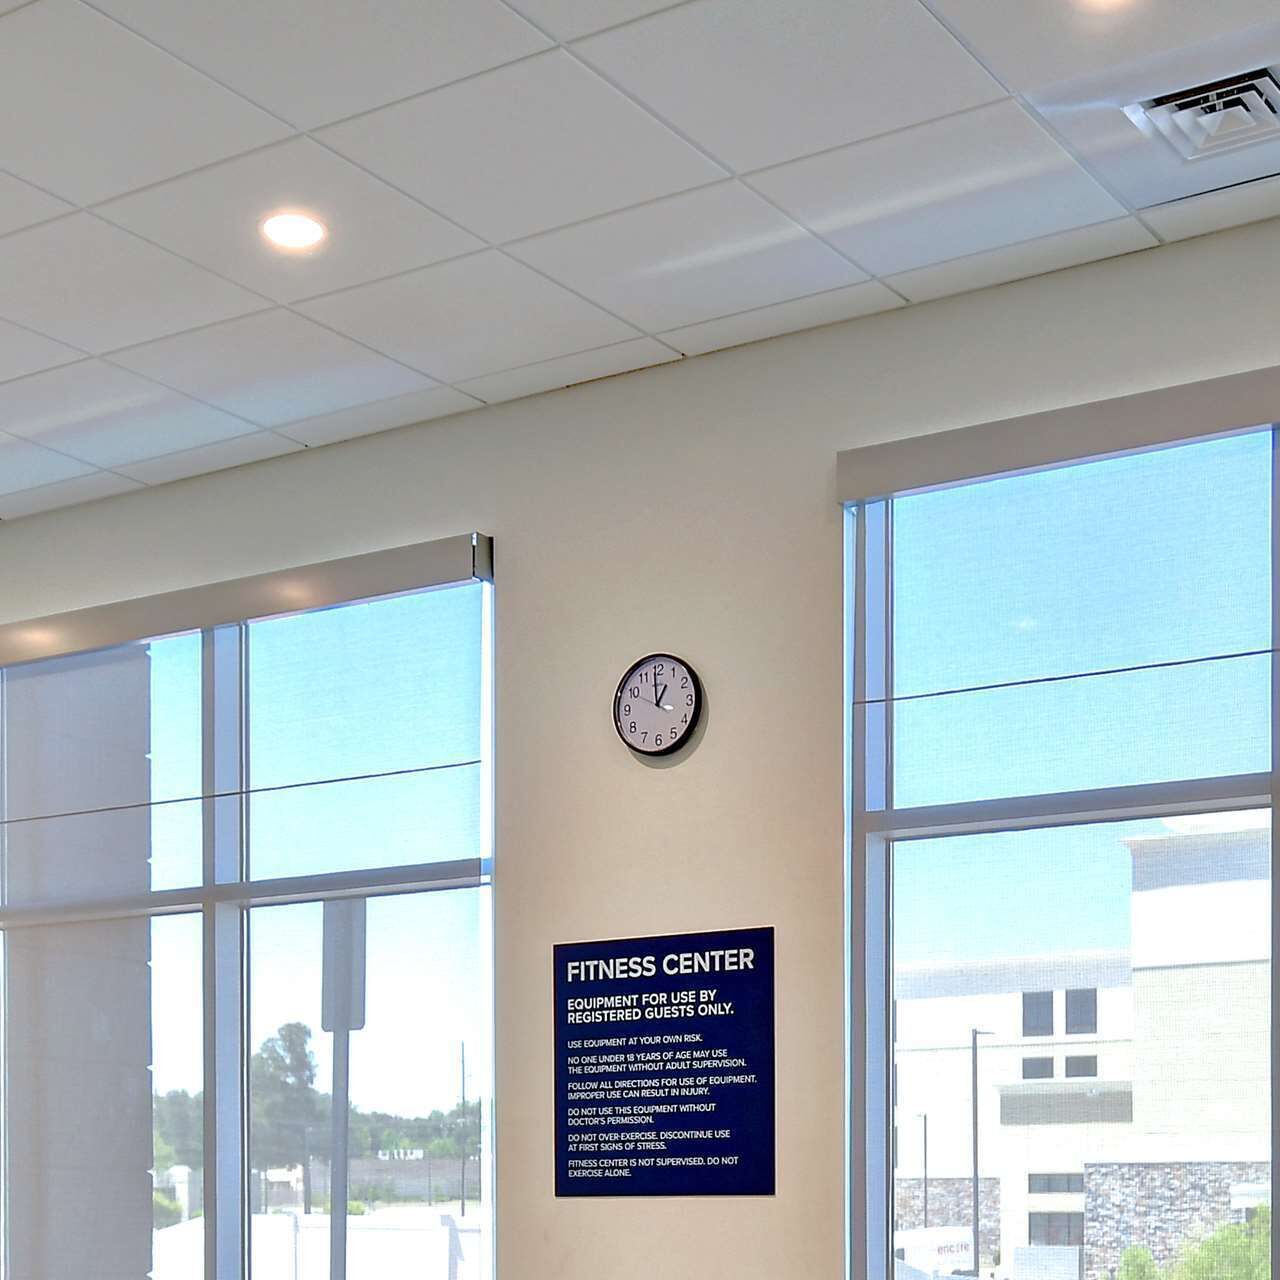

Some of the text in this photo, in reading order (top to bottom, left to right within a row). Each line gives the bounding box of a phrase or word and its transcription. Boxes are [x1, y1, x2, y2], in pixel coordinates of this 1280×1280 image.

[639, 672, 648, 683] 11
[672, 667, 675, 678] 1
[681, 677, 688, 688] 2
[629, 686, 639, 698] 10
[686, 694, 693, 706] 3
[624, 705, 631, 716] 9
[681, 713, 688, 724] 4
[630, 722, 636, 733] 8
[670, 727, 677, 739] 5
[641, 732, 648, 743] 7
[655, 734, 663, 746] 6
[567, 948, 754, 981] FITNESS CENTER
[567, 989, 716, 1010] EQUIPMENT FOR USE BY
[567, 1002, 733, 1023] REGISTERED GUESTS ONLY.
[567, 1033, 702, 1048] USE EQUIPMENT AT YOUR OWN RISK.
[567, 1049, 727, 1064] NO ONE UNDER 18 YEARS OF AGE MAY USE
[567, 1058, 746, 1073] THE EQUIPMENT WITHOUT ADULT SUPERVISION.
[567, 1074, 756, 1089] FOLLOW ALL DIRECTIONS FOR USE OF EQUIPMENT.
[567, 1087, 709, 1099] IMPROPER USE CAN RESULT IN INJURY.
[567, 1103, 715, 1115] DO NOT USE THIS EQUIPMENT WITHOUT
[606, 1115, 654, 1124] PERMISSION.
[567, 1133, 580, 1141] DO
[580, 1132, 596, 1141] NOT
[659, 1130, 712, 1139] DISCONTINUE
[714, 1129, 730, 1138] USE
[567, 1143, 577, 1151] AT
[599, 1142, 623, 1150] SIGNS
[624, 1142, 635, 1150] OF
[636, 1141, 666, 1149] STRESS.
[568, 1156, 738, 1167] FITNESS CENTER IS NOT SUPERVISED. DO NOT
